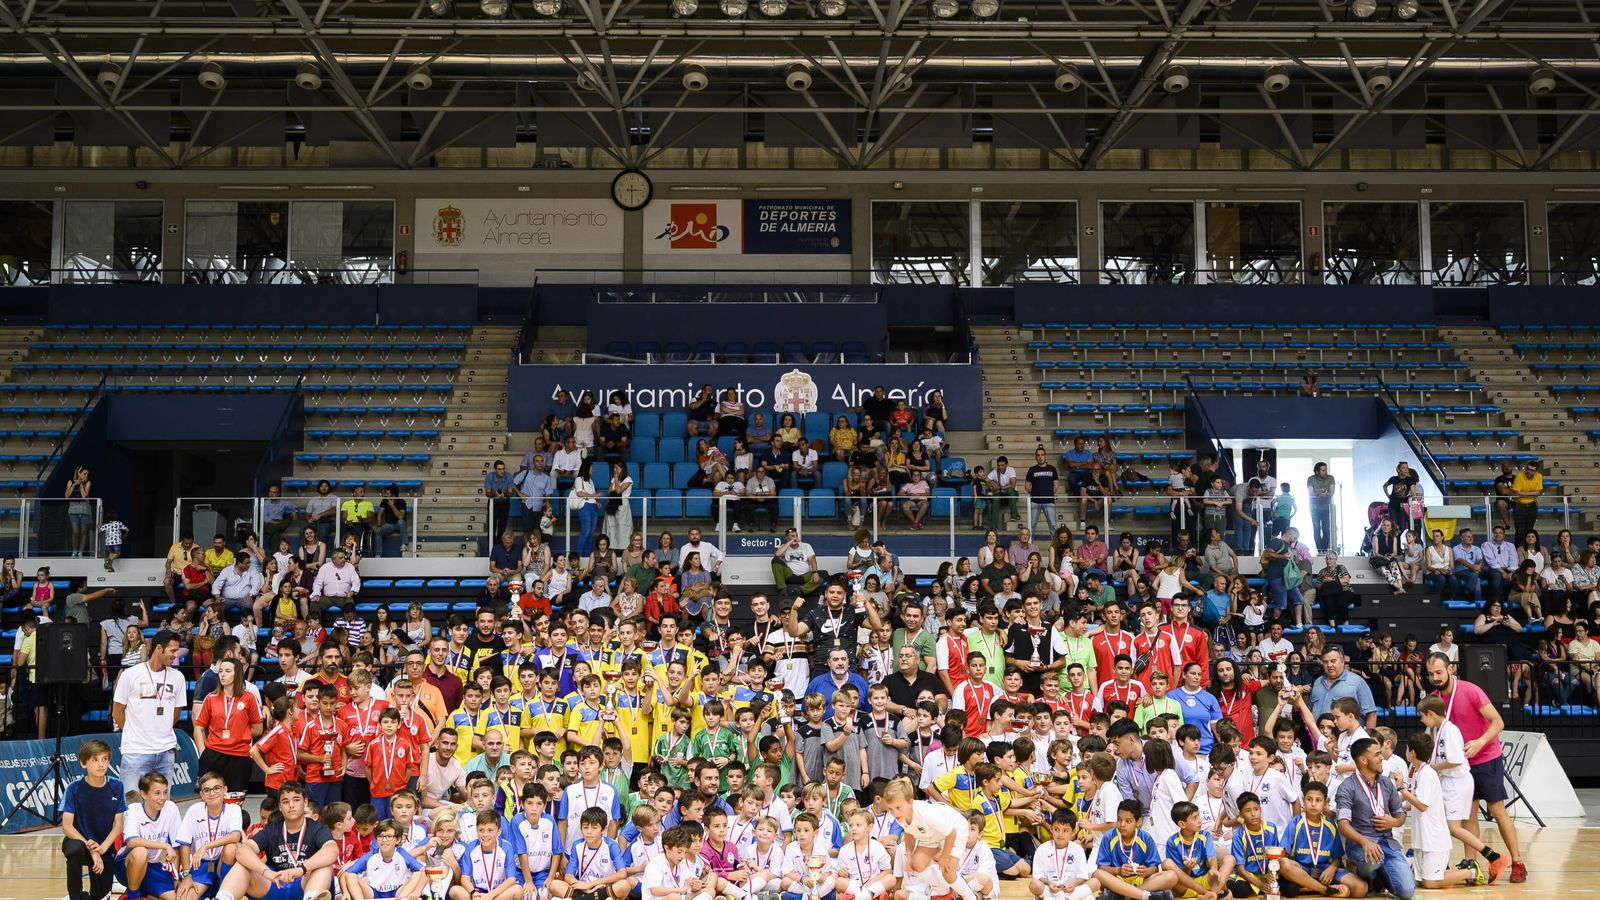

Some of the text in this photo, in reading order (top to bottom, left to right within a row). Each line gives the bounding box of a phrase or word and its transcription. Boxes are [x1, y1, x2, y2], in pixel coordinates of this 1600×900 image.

[483, 209, 608, 228] Ayuntamiento
[759, 211, 837, 221] DEPORTES
[759, 222, 836, 233] DE ALMERIA
[483, 227, 552, 246] Almería
[741, 538, 768, 548] Sector
[774, 538, 782, 548] D
